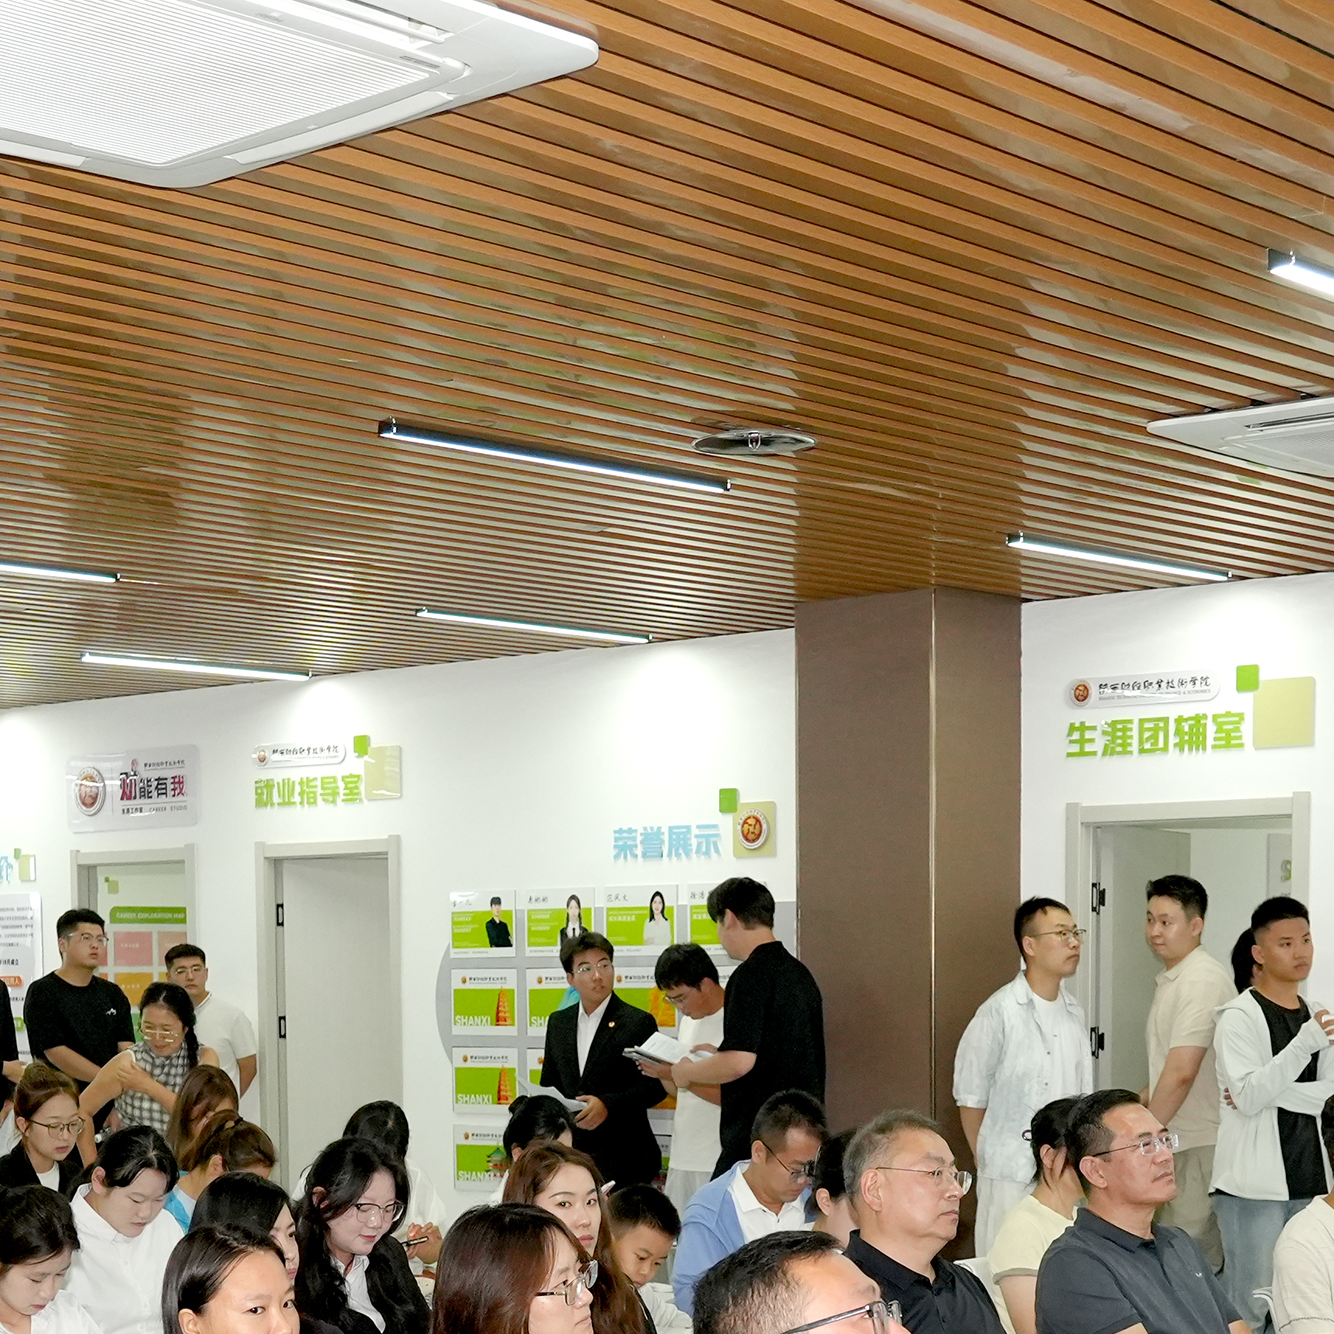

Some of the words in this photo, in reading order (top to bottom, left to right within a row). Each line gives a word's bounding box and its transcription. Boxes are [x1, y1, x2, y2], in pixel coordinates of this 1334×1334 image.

[1066, 711, 1245, 758] 生涯团辅室
[254, 773, 363, 808] 就业指导室
[613, 824, 722, 859] 荣誉展示
[455, 1015, 491, 1026] SHANXI
[531, 1016, 549, 1027] SHA
[457, 1094, 493, 1104] SHANXI
